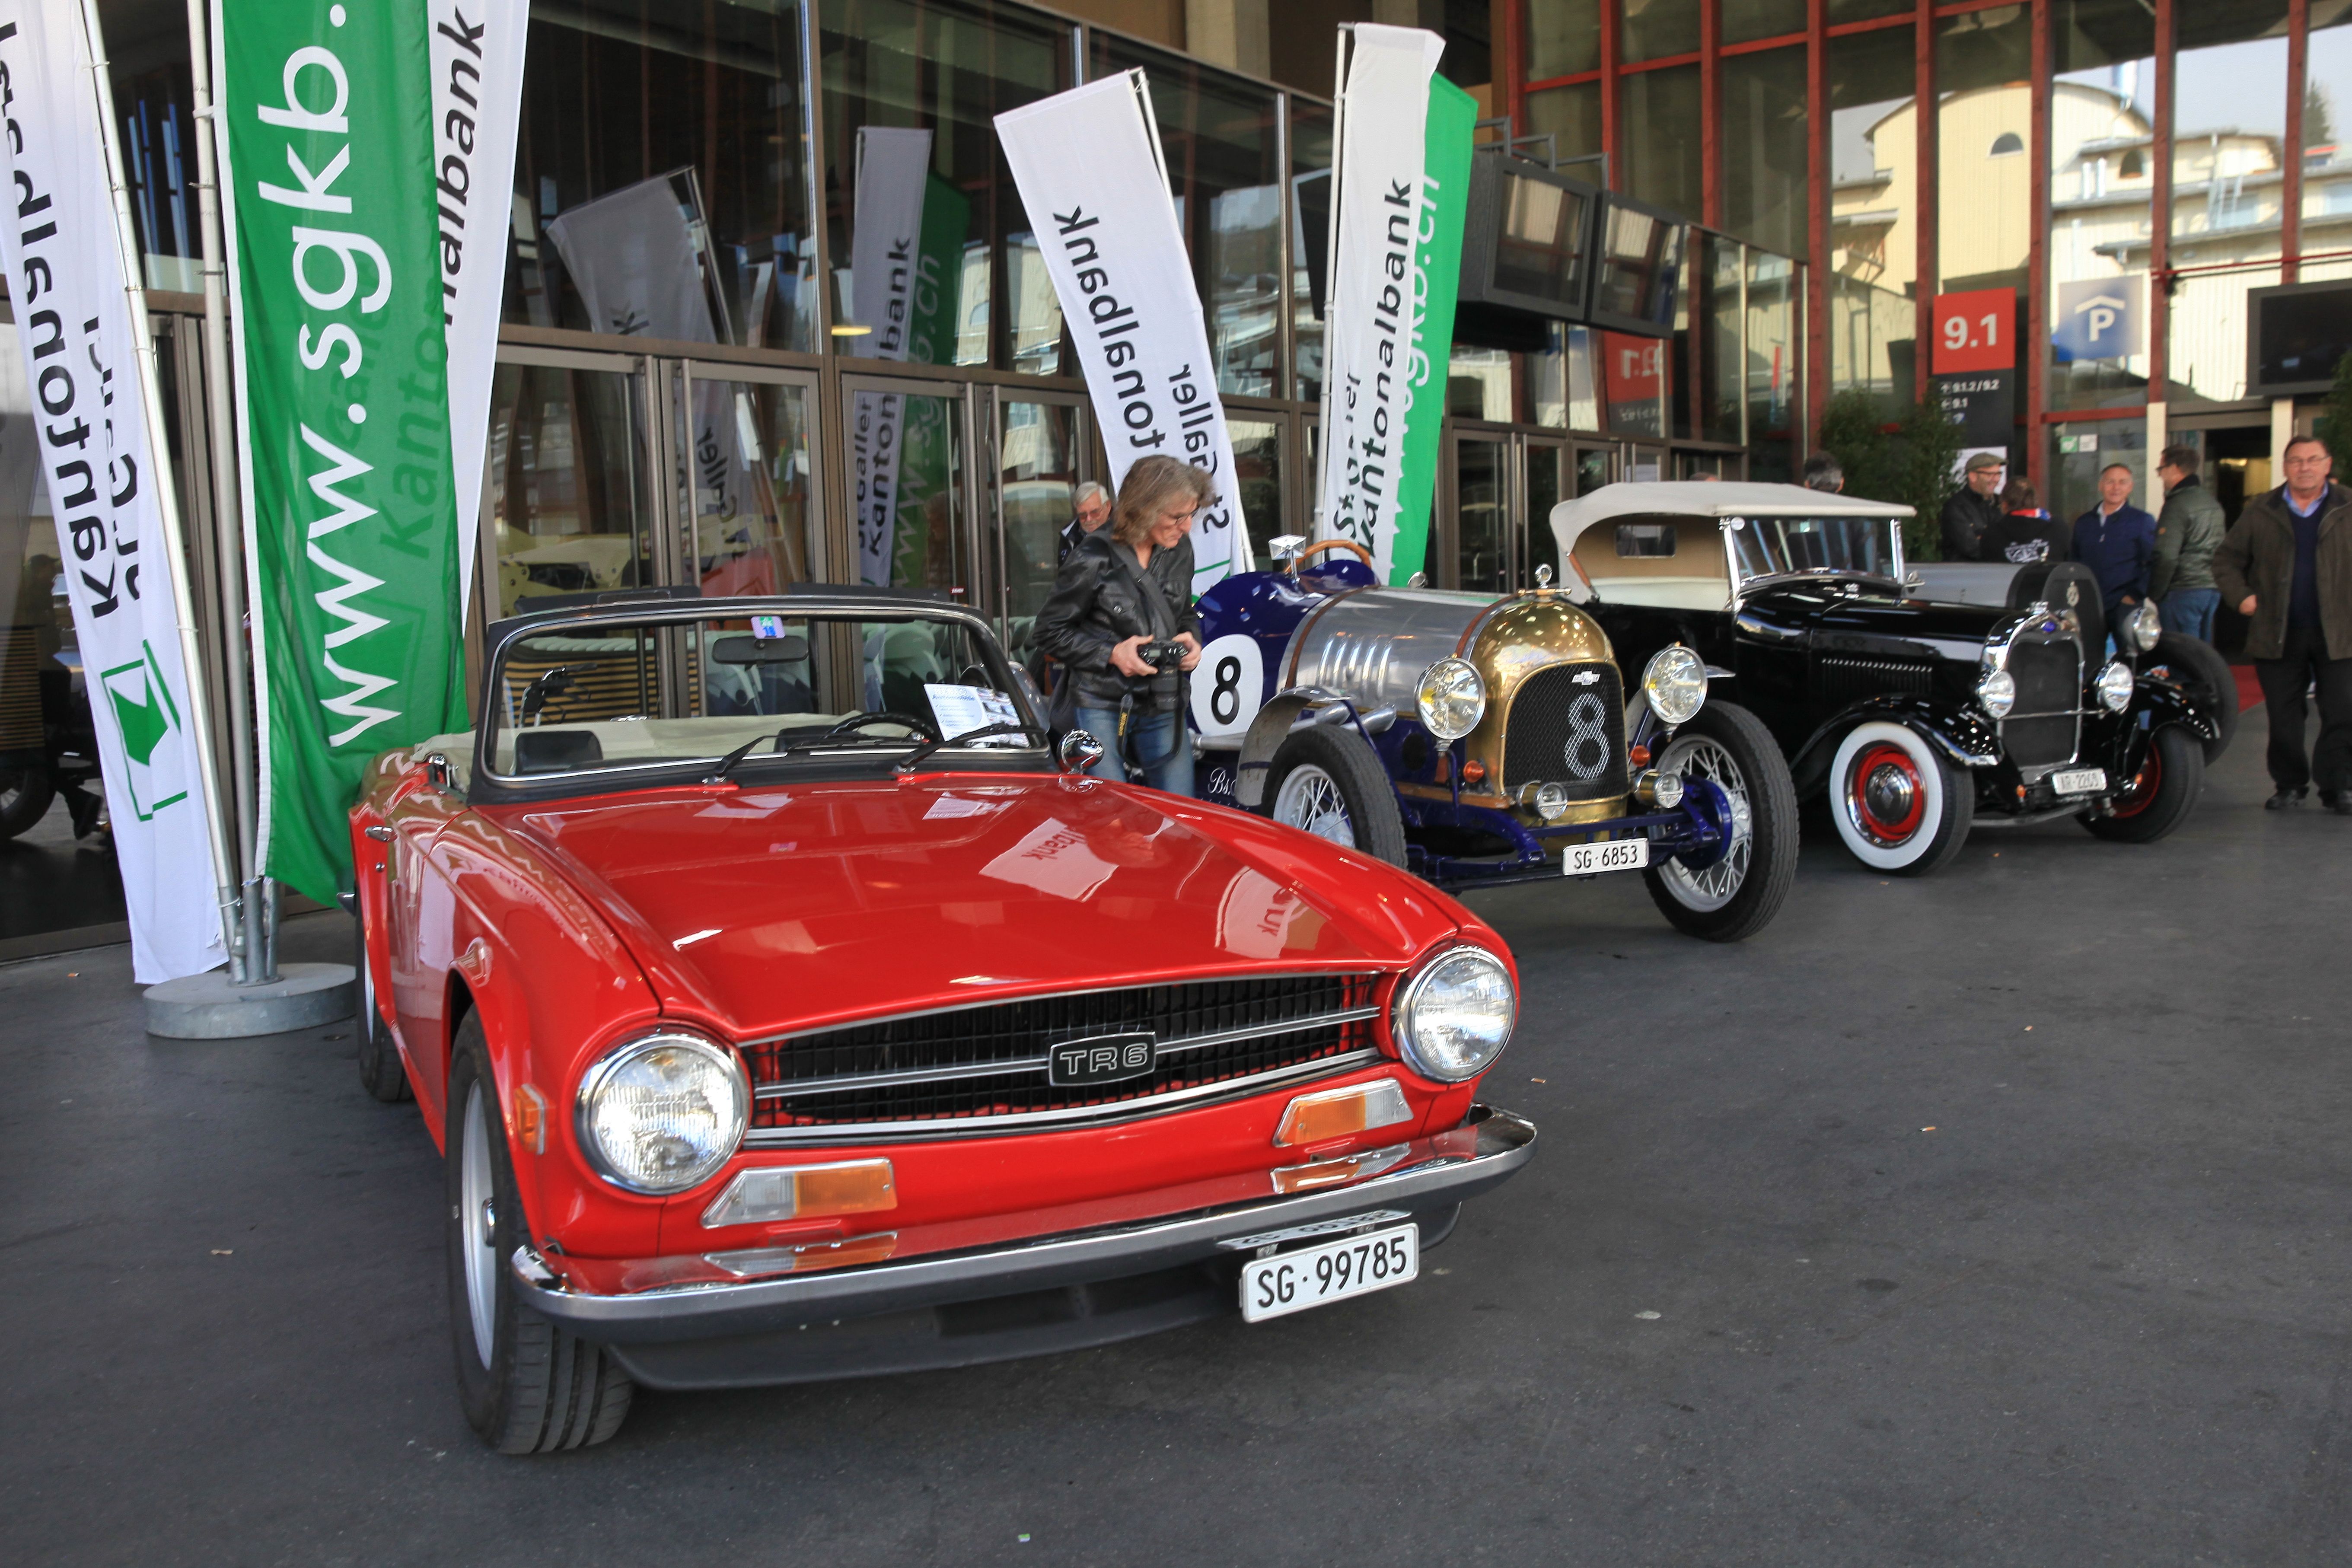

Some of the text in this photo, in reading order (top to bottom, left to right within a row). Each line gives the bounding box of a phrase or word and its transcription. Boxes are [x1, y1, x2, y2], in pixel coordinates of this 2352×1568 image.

[1944, 313, 1997, 350] 9.1
[2089, 309, 2116, 342] P
[1211, 656, 1241, 725] 8
[1564, 693, 1611, 780] 8
[1059, 1042, 1148, 1075] TR6
